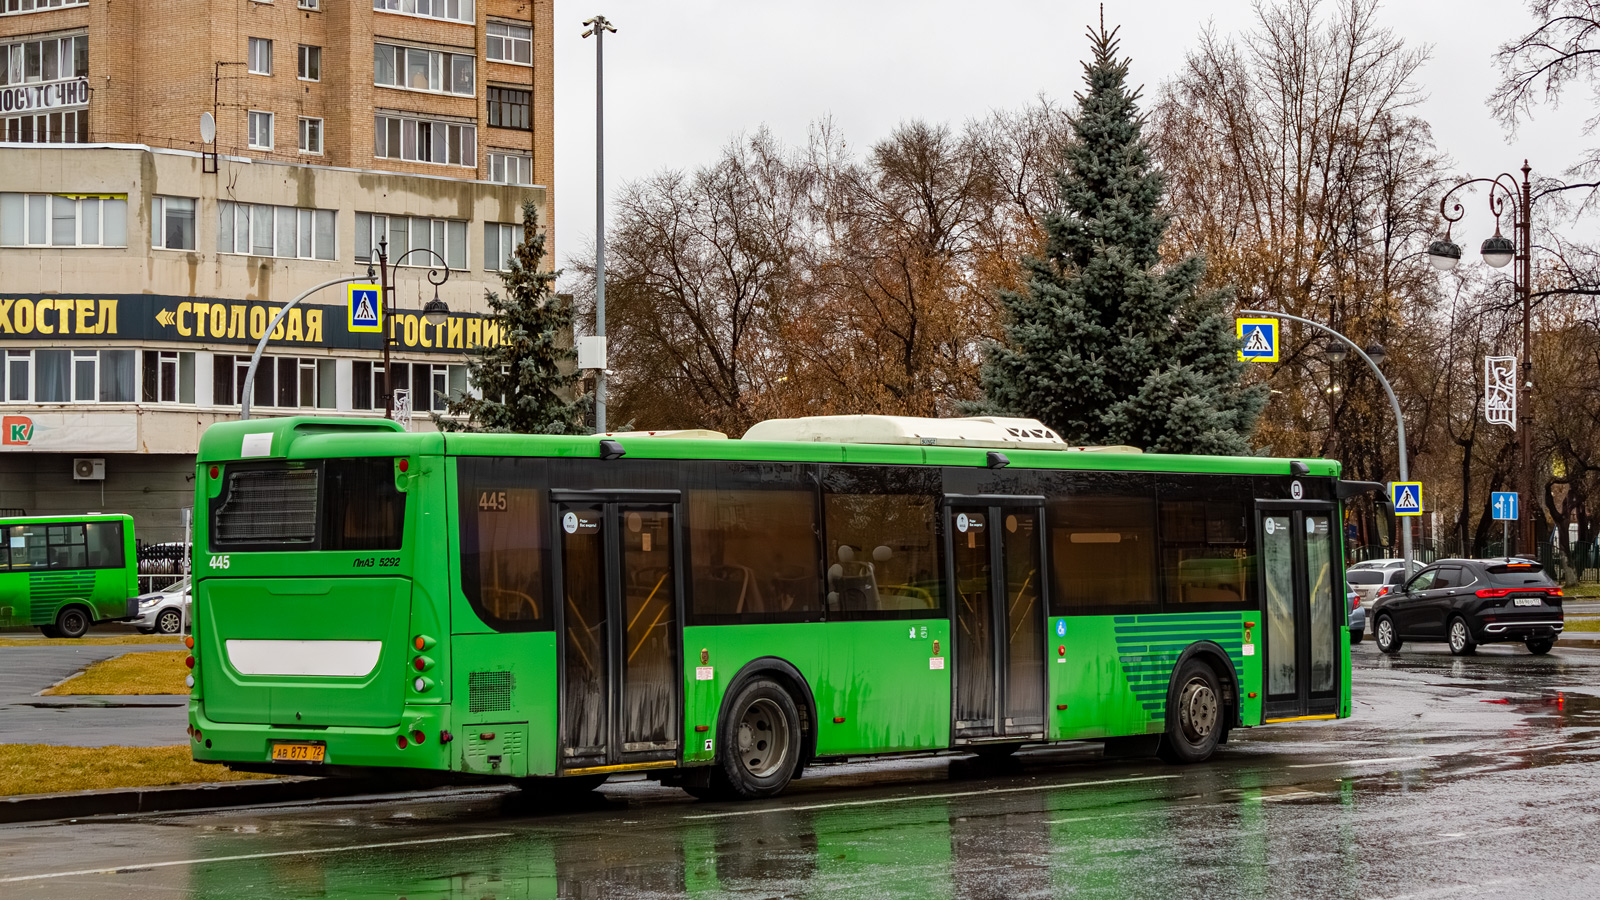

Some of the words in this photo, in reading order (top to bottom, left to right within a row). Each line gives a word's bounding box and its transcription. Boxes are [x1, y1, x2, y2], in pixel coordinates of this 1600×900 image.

[0, 80, 88, 111] ОСУТОЧНО
[0, 298, 118, 334] ХОСТЕЛ
[176, 301, 323, 342] СТОЛОВАЯ
[479, 491, 507, 510] 445
[209, 555, 230, 569] 445
[378, 557, 401, 567] 5292
[290, 746, 308, 759] 873
[312, 746, 322, 756] 72
